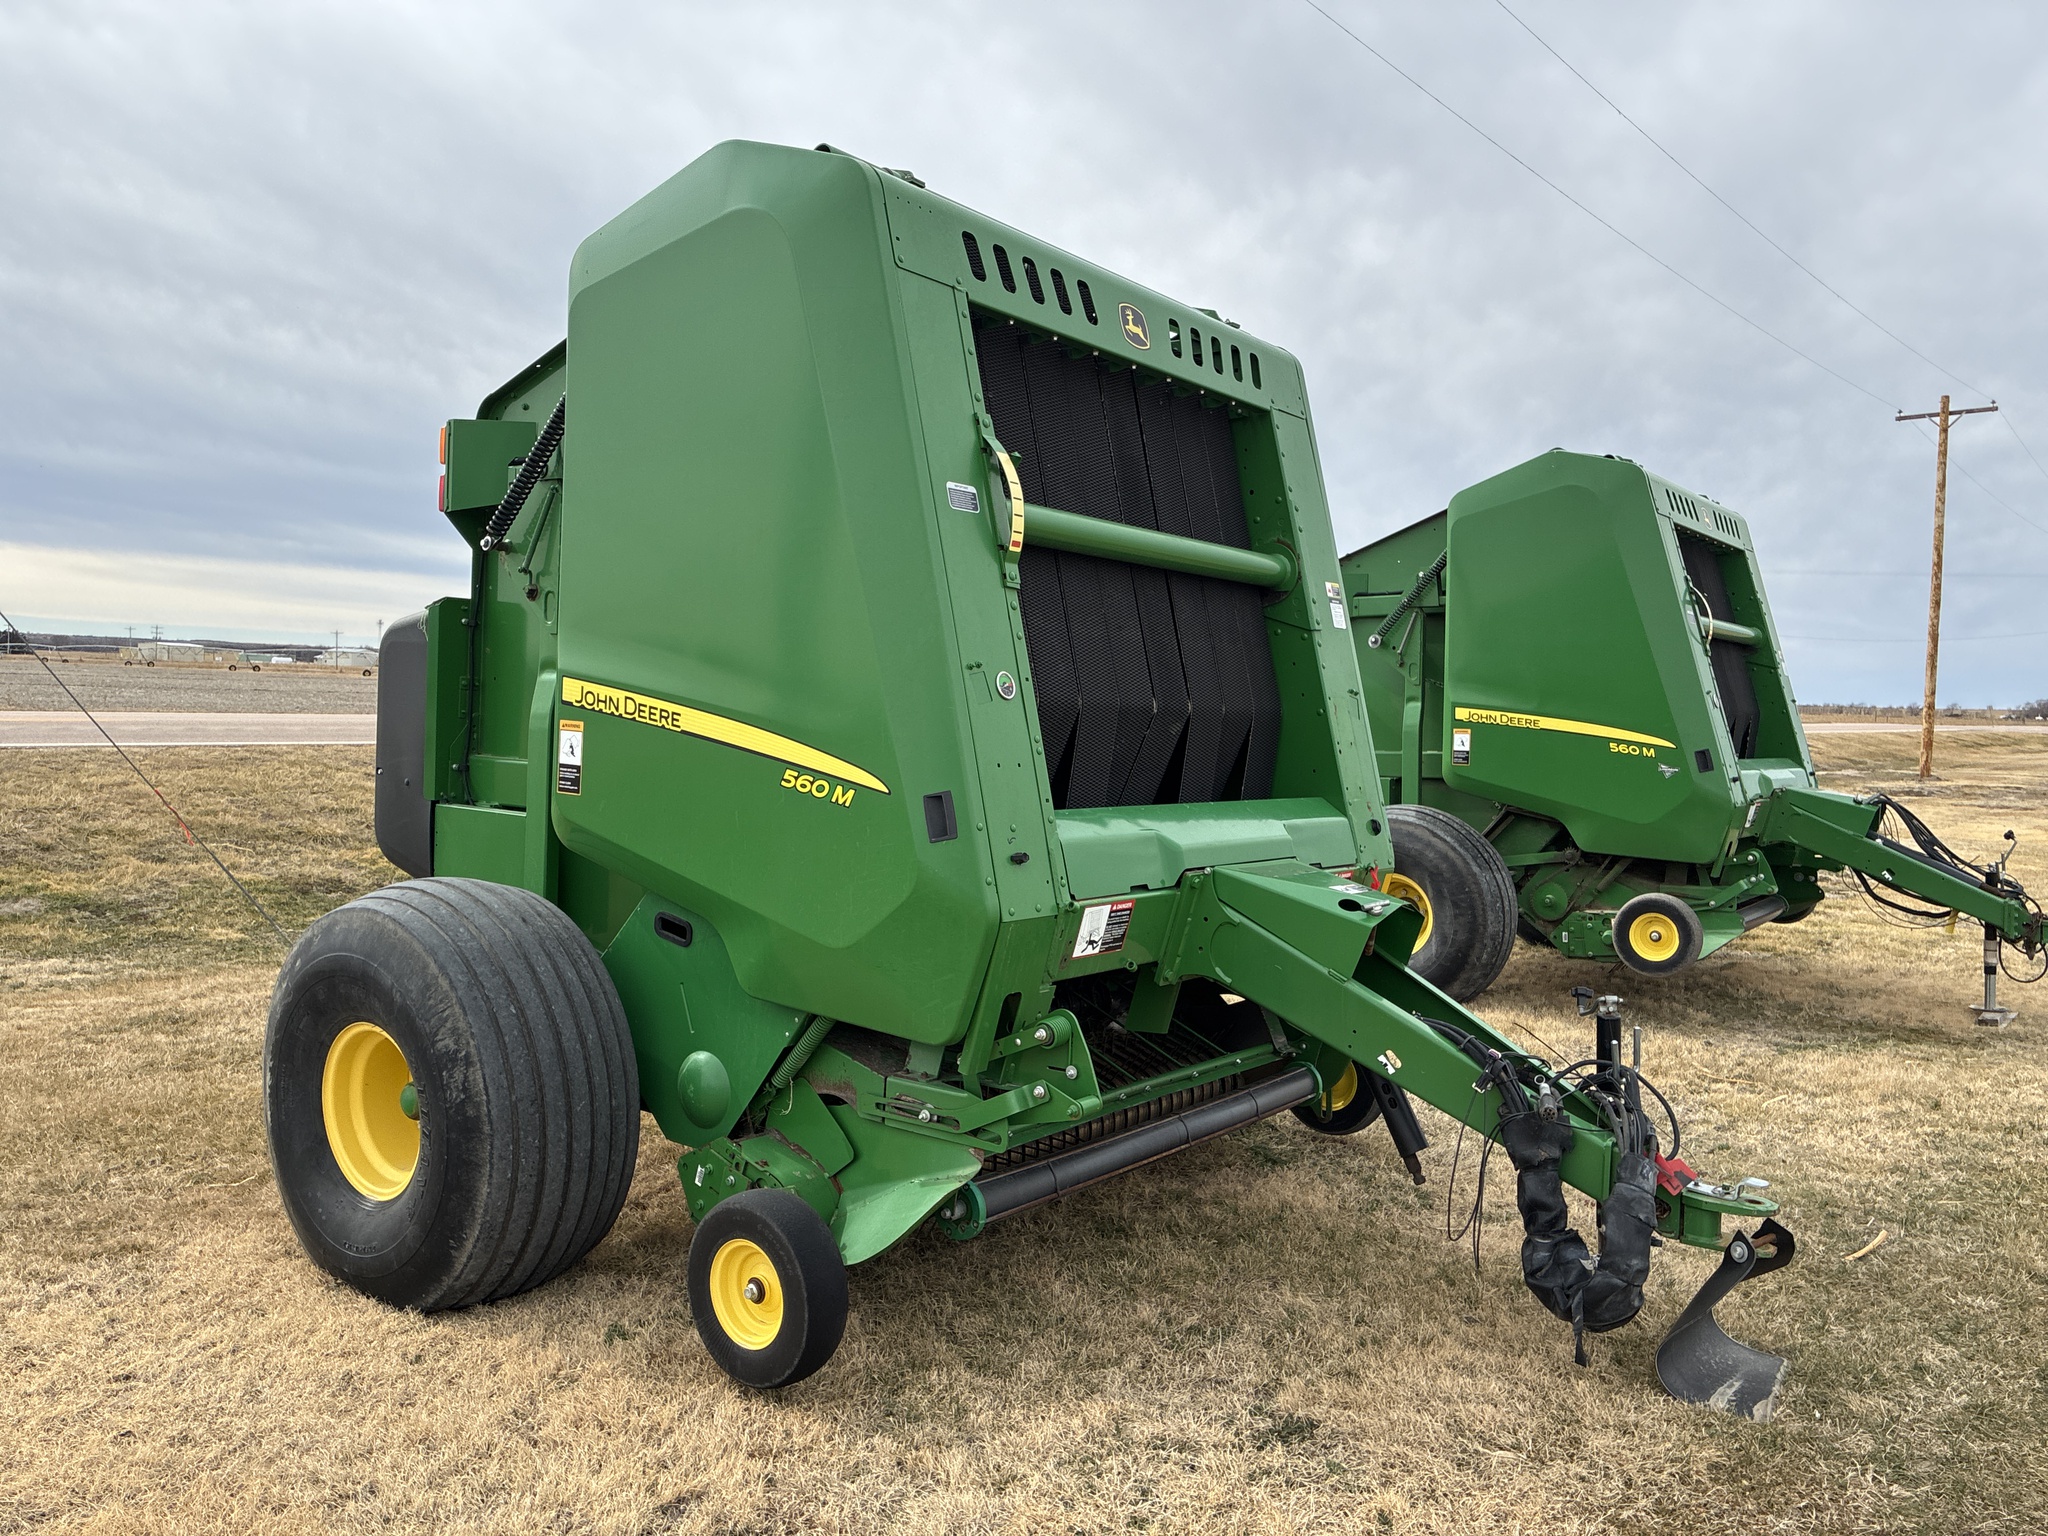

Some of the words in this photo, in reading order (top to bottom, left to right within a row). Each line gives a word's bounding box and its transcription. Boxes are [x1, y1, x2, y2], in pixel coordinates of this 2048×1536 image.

[575, 685, 620, 713] JOHN
[624, 695, 682, 729] DEERE
[1464, 711, 1497, 723] JOHN
[1500, 714, 1541, 728] DEERE
[1609, 742, 1640, 756] 560
[1642, 746, 1656, 758] M
[780, 768, 830, 798] 560
[830, 784, 857, 808] M
